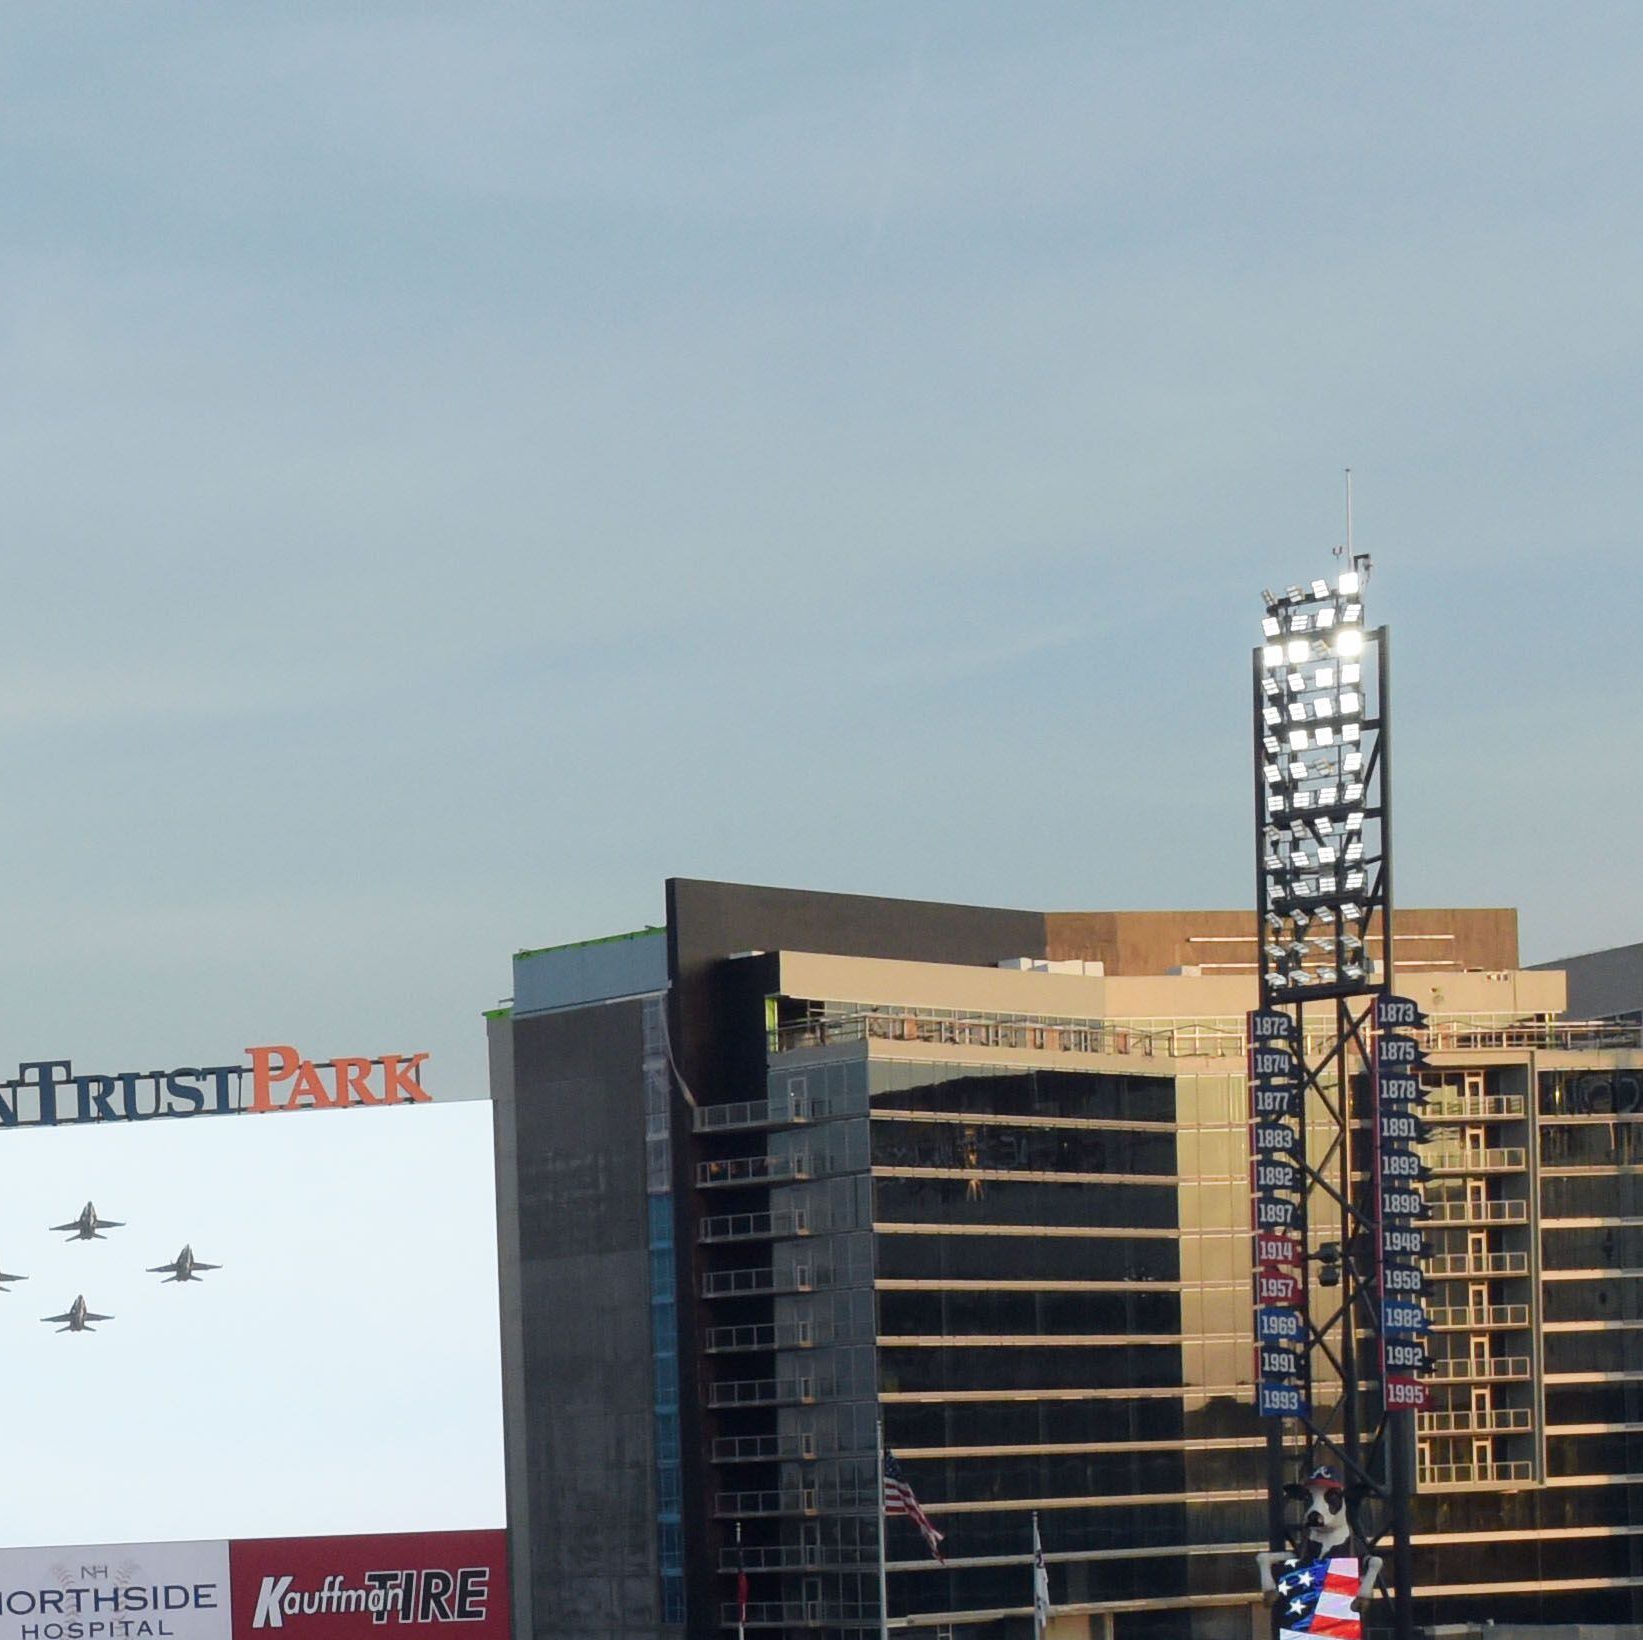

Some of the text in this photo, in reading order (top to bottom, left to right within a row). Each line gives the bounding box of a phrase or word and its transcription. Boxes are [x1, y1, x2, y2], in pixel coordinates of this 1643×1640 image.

[1379, 1003, 1414, 1022] 1873
[1255, 1017, 1288, 1035] 1872
[1380, 1042, 1414, 1060] 1875
[1256, 1055, 1289, 1073] 1874
[244, 1044, 432, 1114] PARK
[1381, 1080, 1416, 1098] 1878
[1257, 1092, 1289, 1110] 1877
[1382, 1118, 1416, 1136] 1891
[1258, 1129, 1292, 1148] 1883
[1382, 1156, 1418, 1175] 1893
[1258, 1167, 1293, 1185] 1892
[1259, 1204, 1292, 1222] 1897
[1383, 1194, 1420, 1213] 1898
[1260, 1242, 1292, 1260] 1914
[1384, 1232, 1420, 1251] 1948
[1261, 1279, 1294, 1297] 1957
[1385, 1270, 1420, 1289] 1958
[1262, 1316, 1297, 1335] 1969
[1386, 1308, 1422, 1328] 1982
[1263, 1353, 1296, 1373] 1991
[1387, 1346, 1423, 1365] 1992
[1264, 1391, 1298, 1409] 1993
[1388, 1384, 1423, 1404] 1995
[252, 1567, 489, 1628] Kauffman TIRE
[21, 1620, 174, 1640] HOSPITAL
